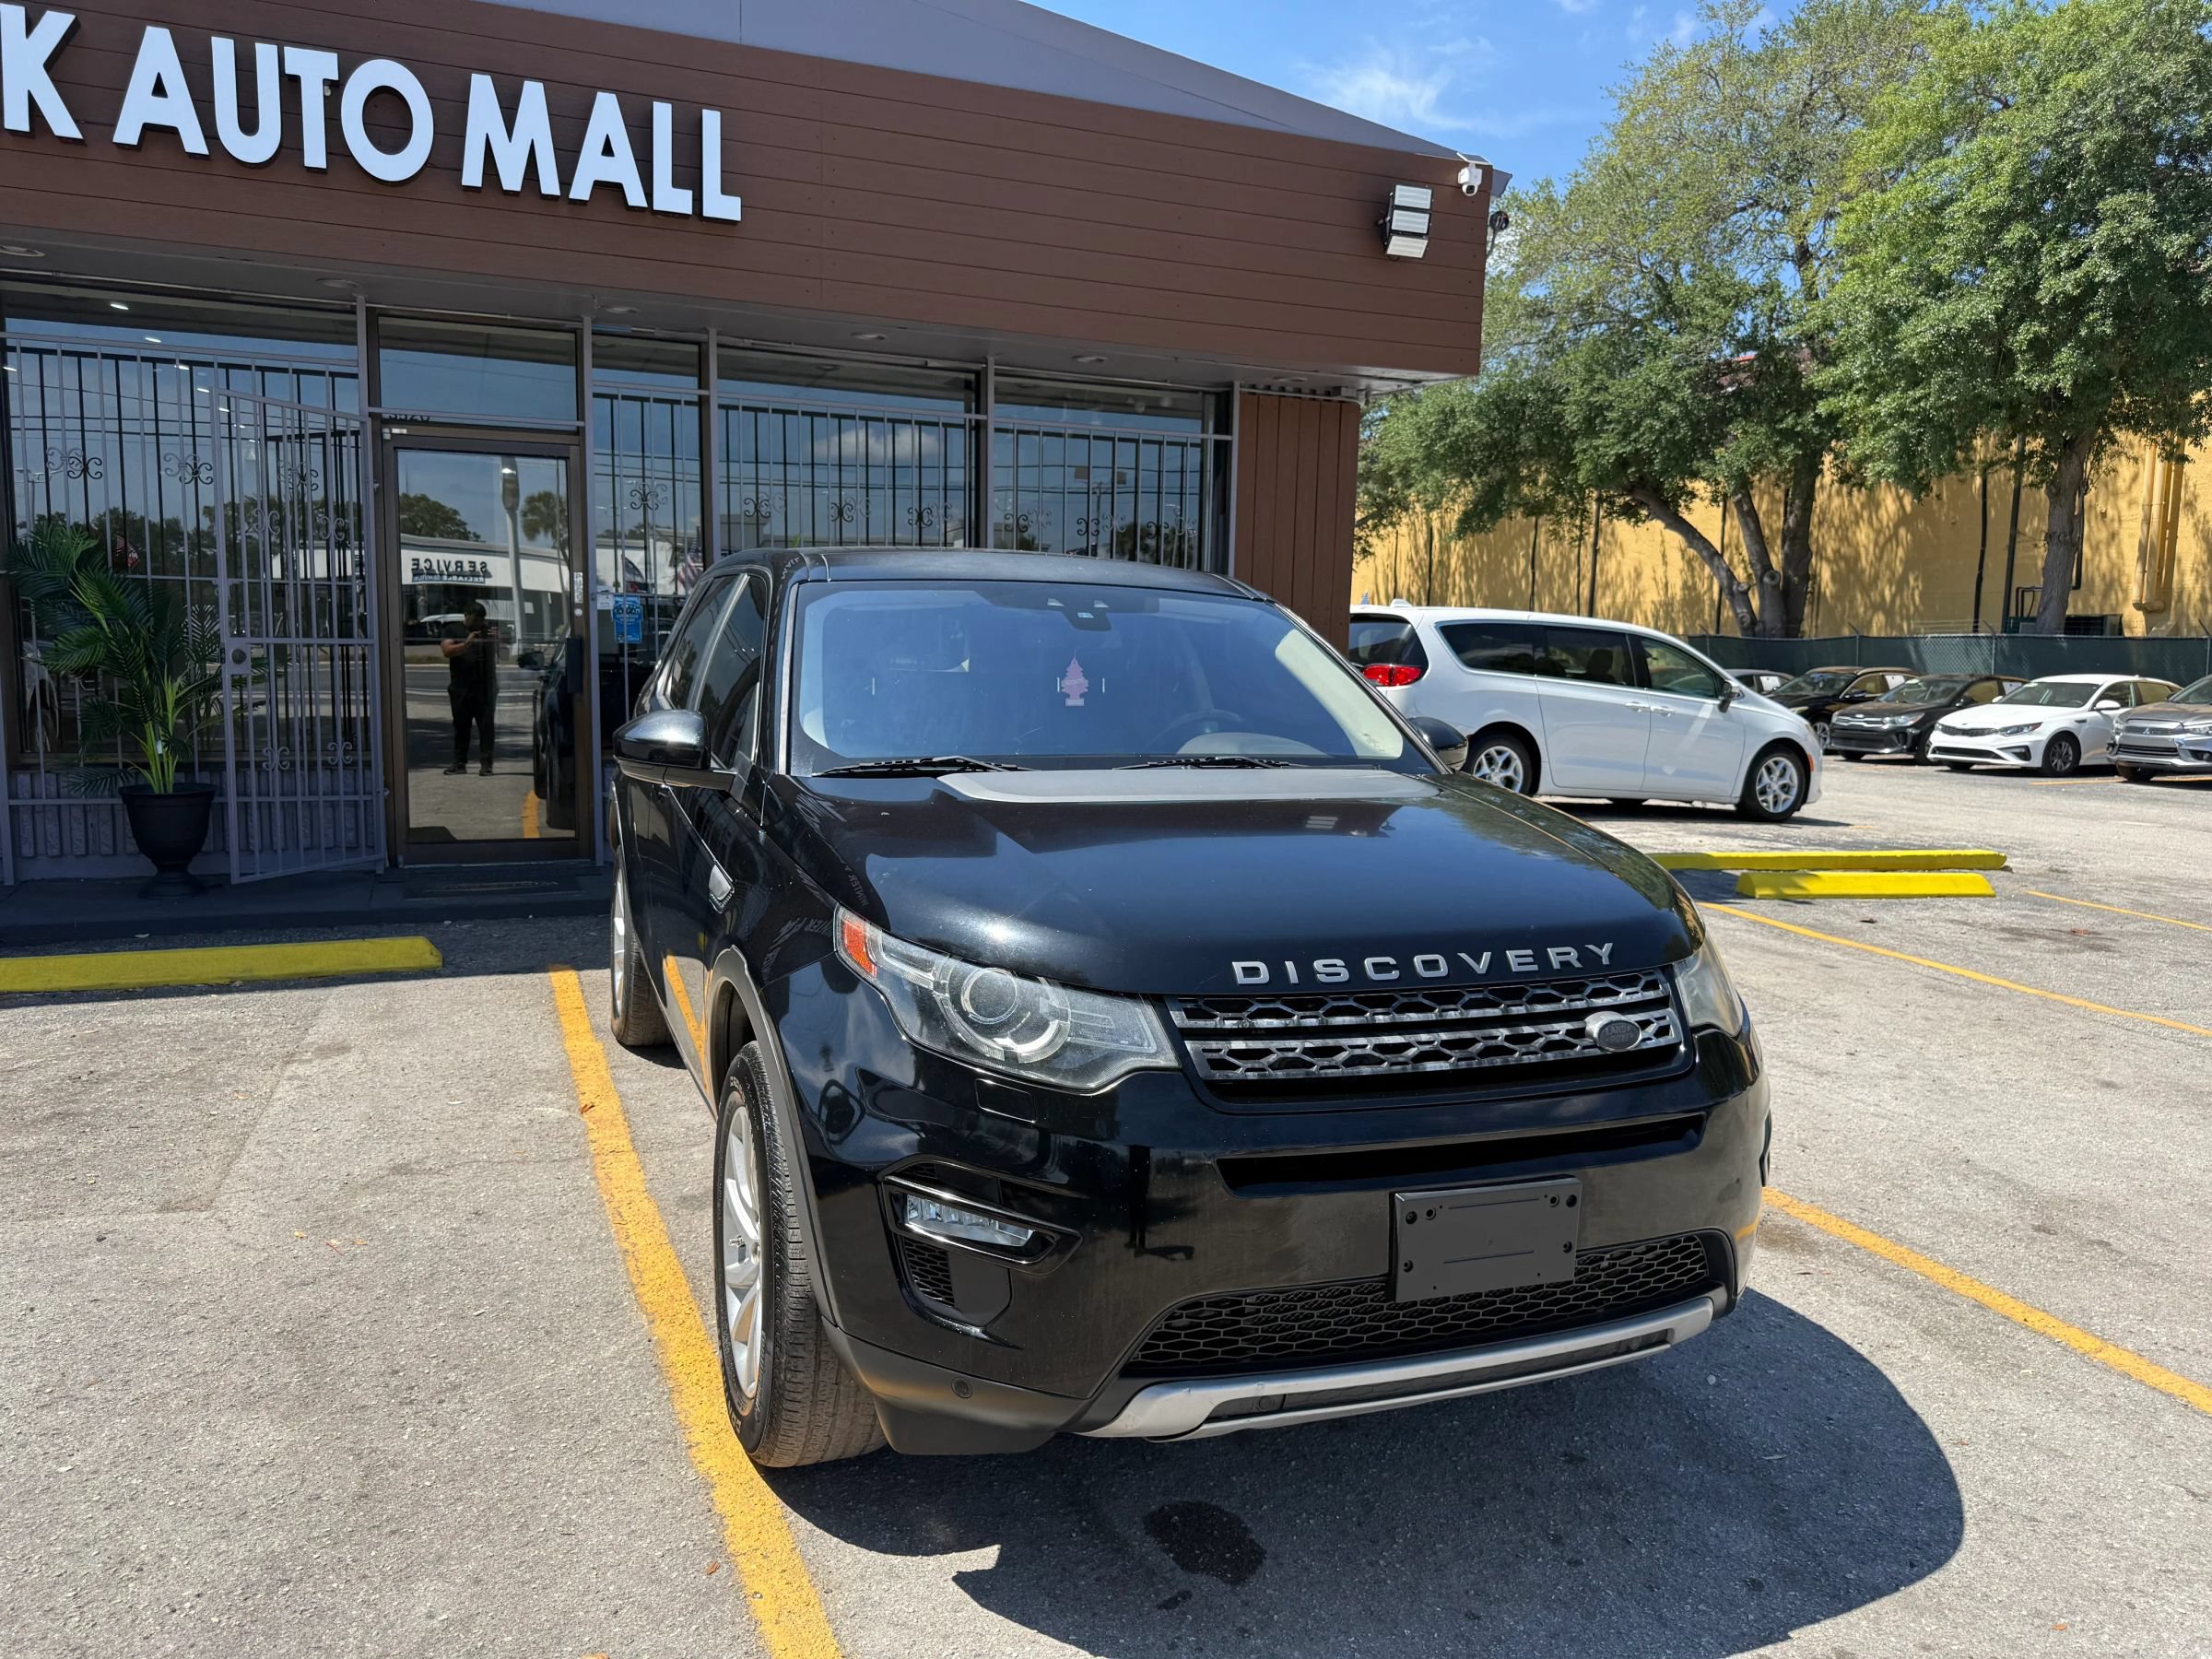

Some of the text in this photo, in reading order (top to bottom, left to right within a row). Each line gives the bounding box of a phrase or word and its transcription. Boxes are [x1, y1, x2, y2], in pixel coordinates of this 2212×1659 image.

[0, 4, 742, 223] K AUTO MALL
[1232, 942, 1615, 985] DISCOVERY
